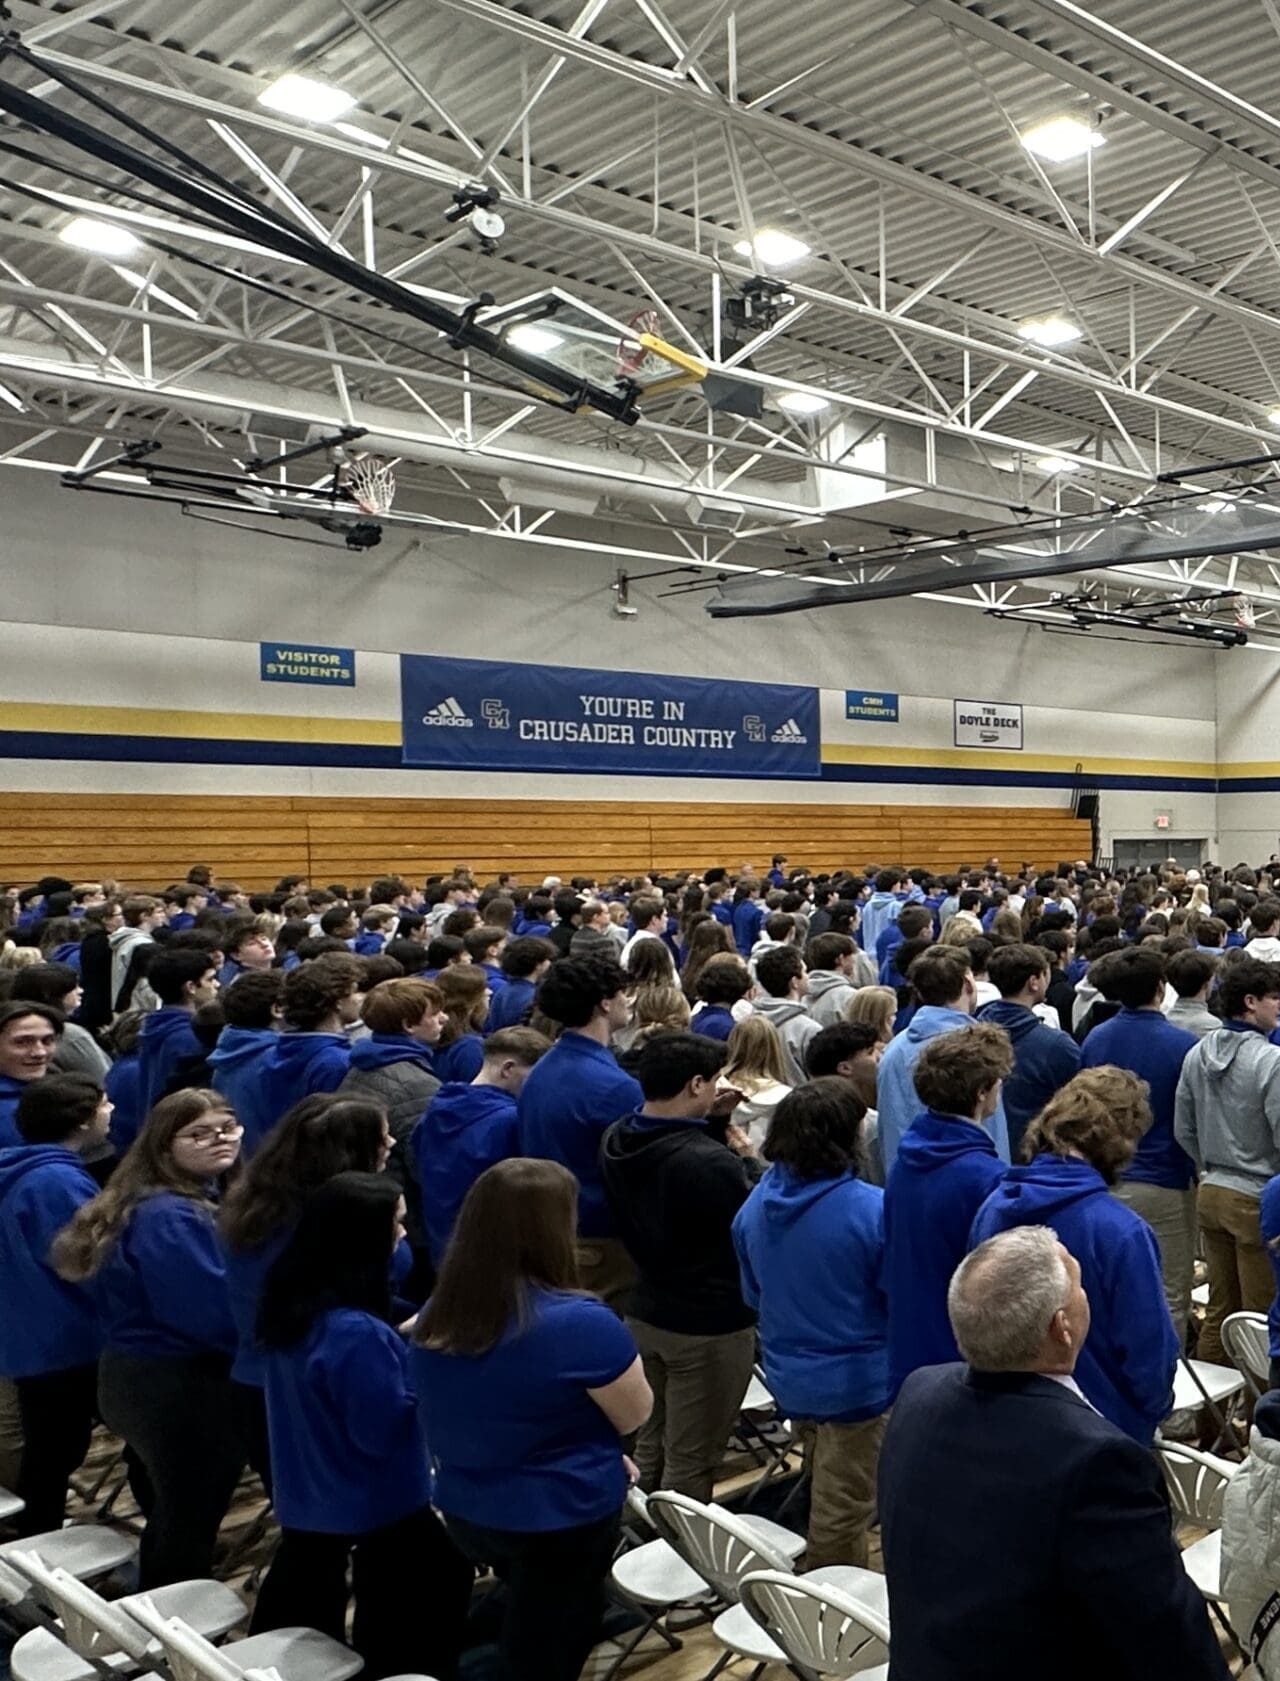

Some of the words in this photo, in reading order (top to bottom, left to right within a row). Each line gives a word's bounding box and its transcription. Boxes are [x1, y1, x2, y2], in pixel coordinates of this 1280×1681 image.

[276, 650, 341, 665] VISITOR
[266, 663, 351, 679] STUDENTS
[580, 695, 655, 719] YOU'RE
[662, 701, 685, 721] IN
[848, 706, 896, 717] STUDENTS
[982, 707, 997, 715] THE
[422, 713, 474, 728] adidas
[959, 715, 991, 726] DOYLE
[993, 717, 1019, 728] DECK
[519, 719, 635, 744] CRUSADER
[643, 726, 737, 749] COUNTRY
[770, 734, 808, 744] adidas
